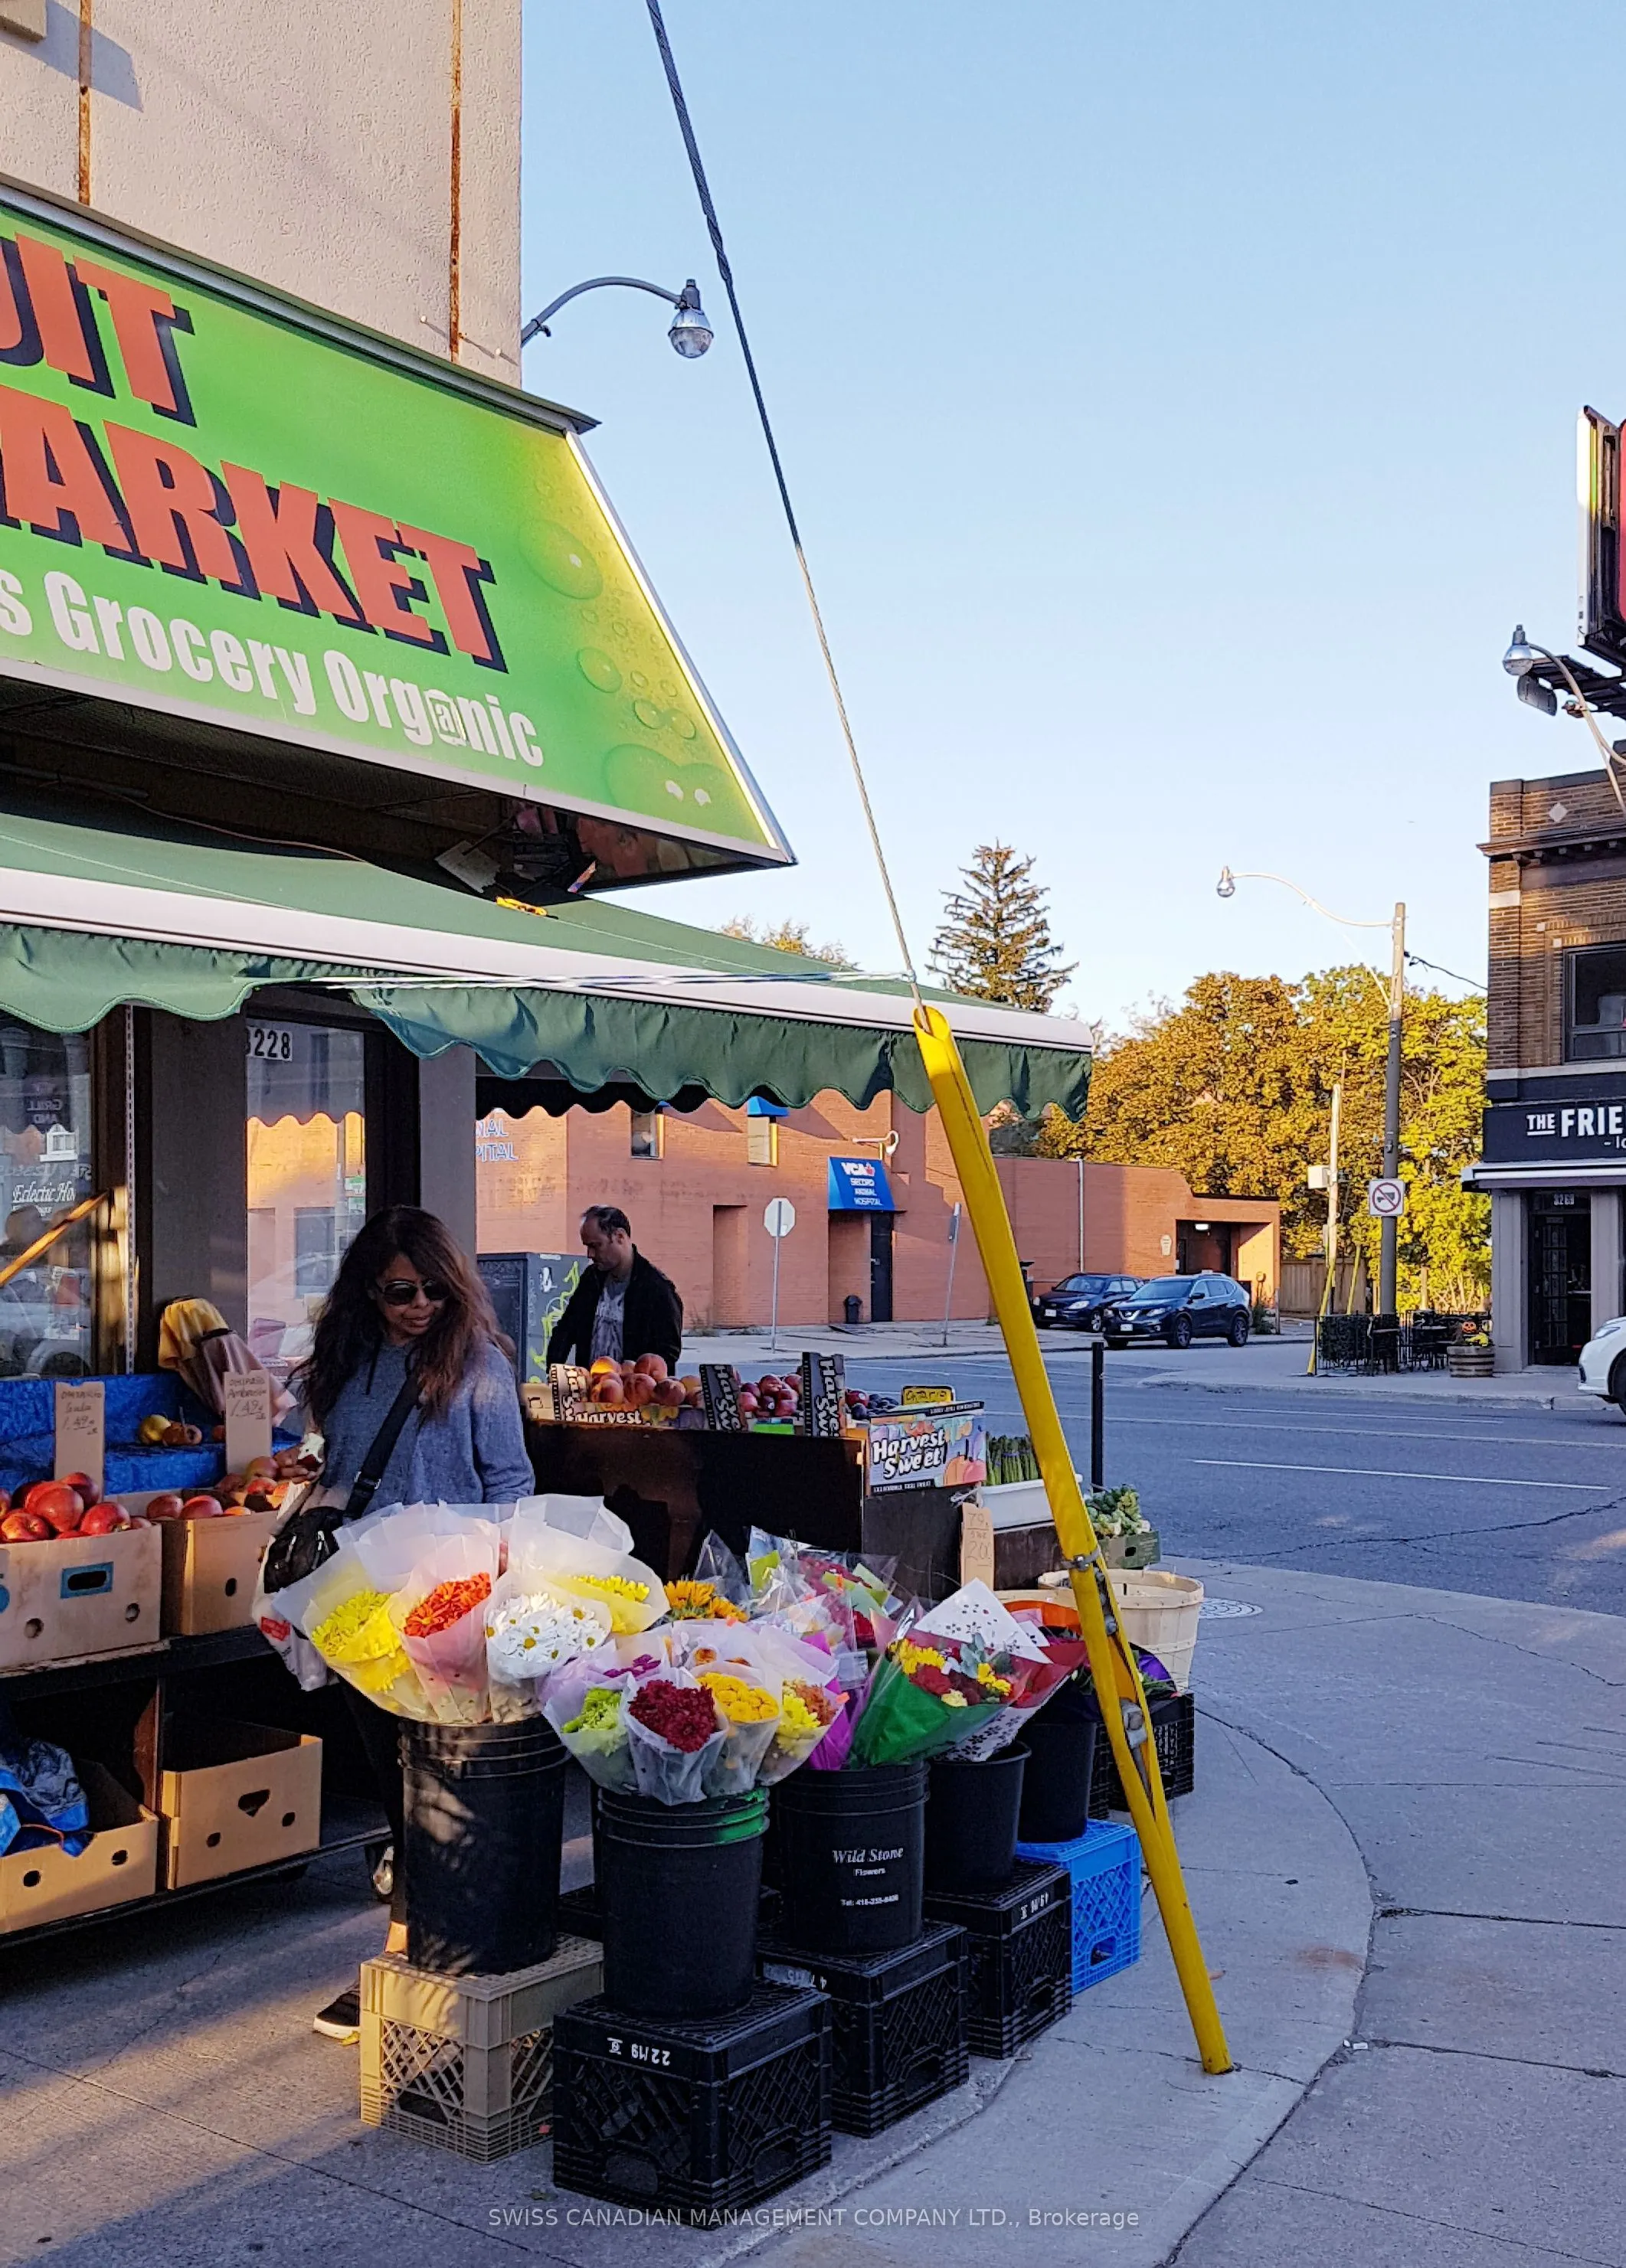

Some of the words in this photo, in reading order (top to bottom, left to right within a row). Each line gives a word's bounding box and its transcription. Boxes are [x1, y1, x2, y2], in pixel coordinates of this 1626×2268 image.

[44, 570, 316, 716] Grocery
[1526, 1113, 1556, 1130] THE
[1561, 1106, 1624, 1138] FRIE
[872, 1428, 945, 1463] Harvest
[884, 1446, 942, 1479] Sweet
[833, 1848, 866, 1864] Wild
[868, 1847, 904, 1862] Stone
